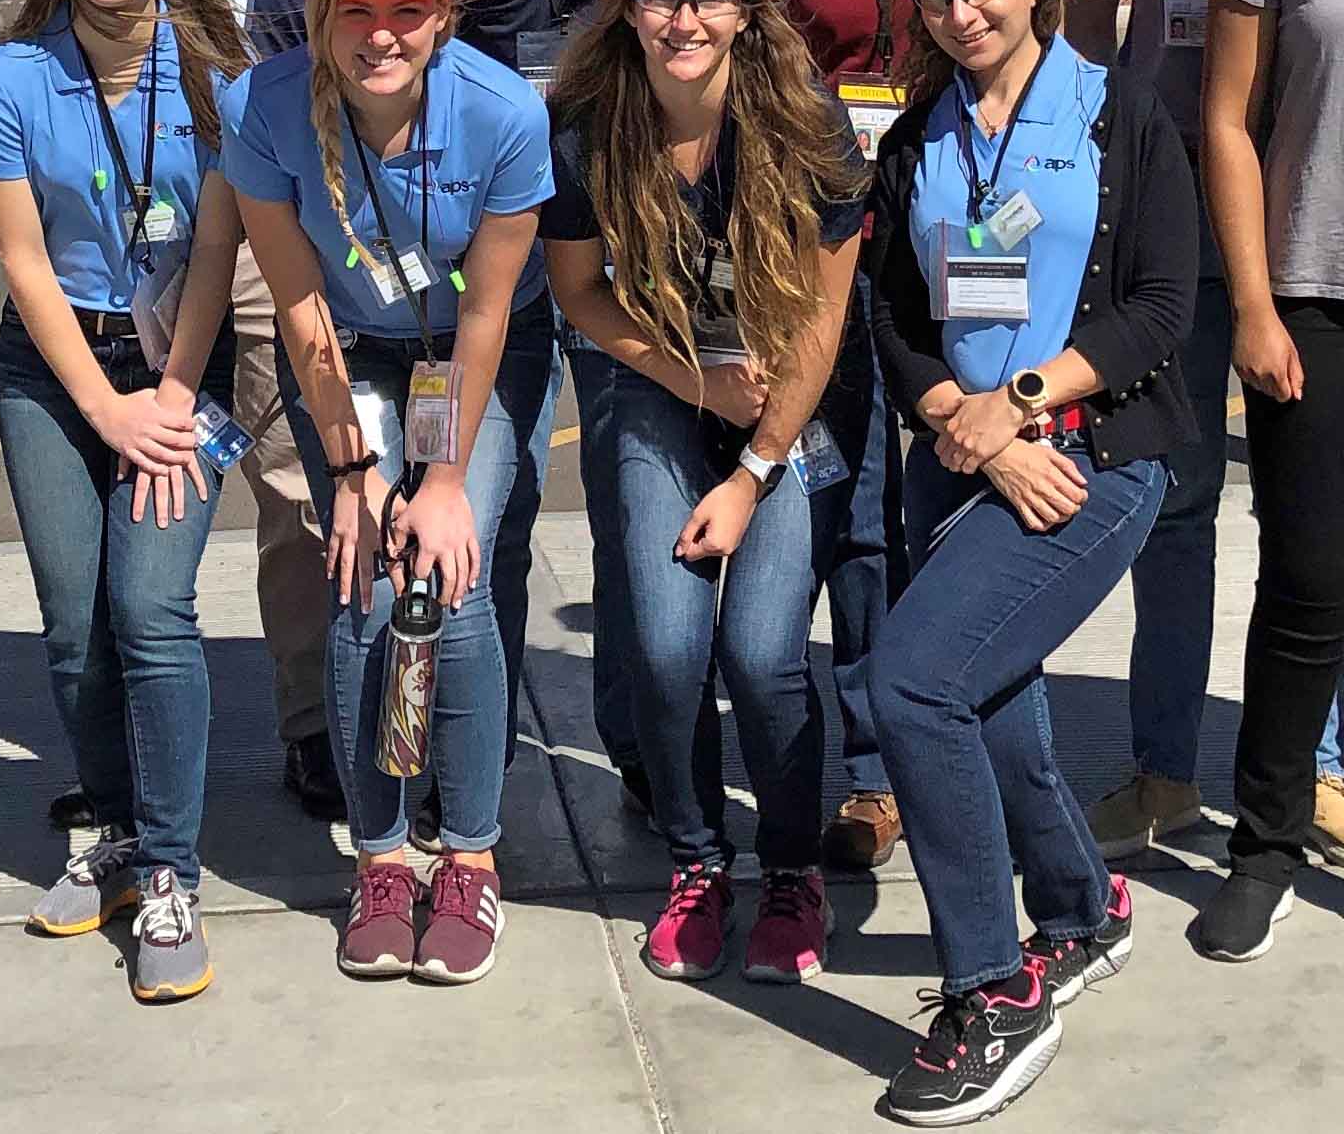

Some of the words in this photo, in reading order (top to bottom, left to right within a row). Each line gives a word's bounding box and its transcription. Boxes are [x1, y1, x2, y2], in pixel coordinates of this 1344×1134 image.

[173, 125, 195, 138] ap
[1044, 158, 1076, 172] aps
[441, 180, 470, 195] aps
